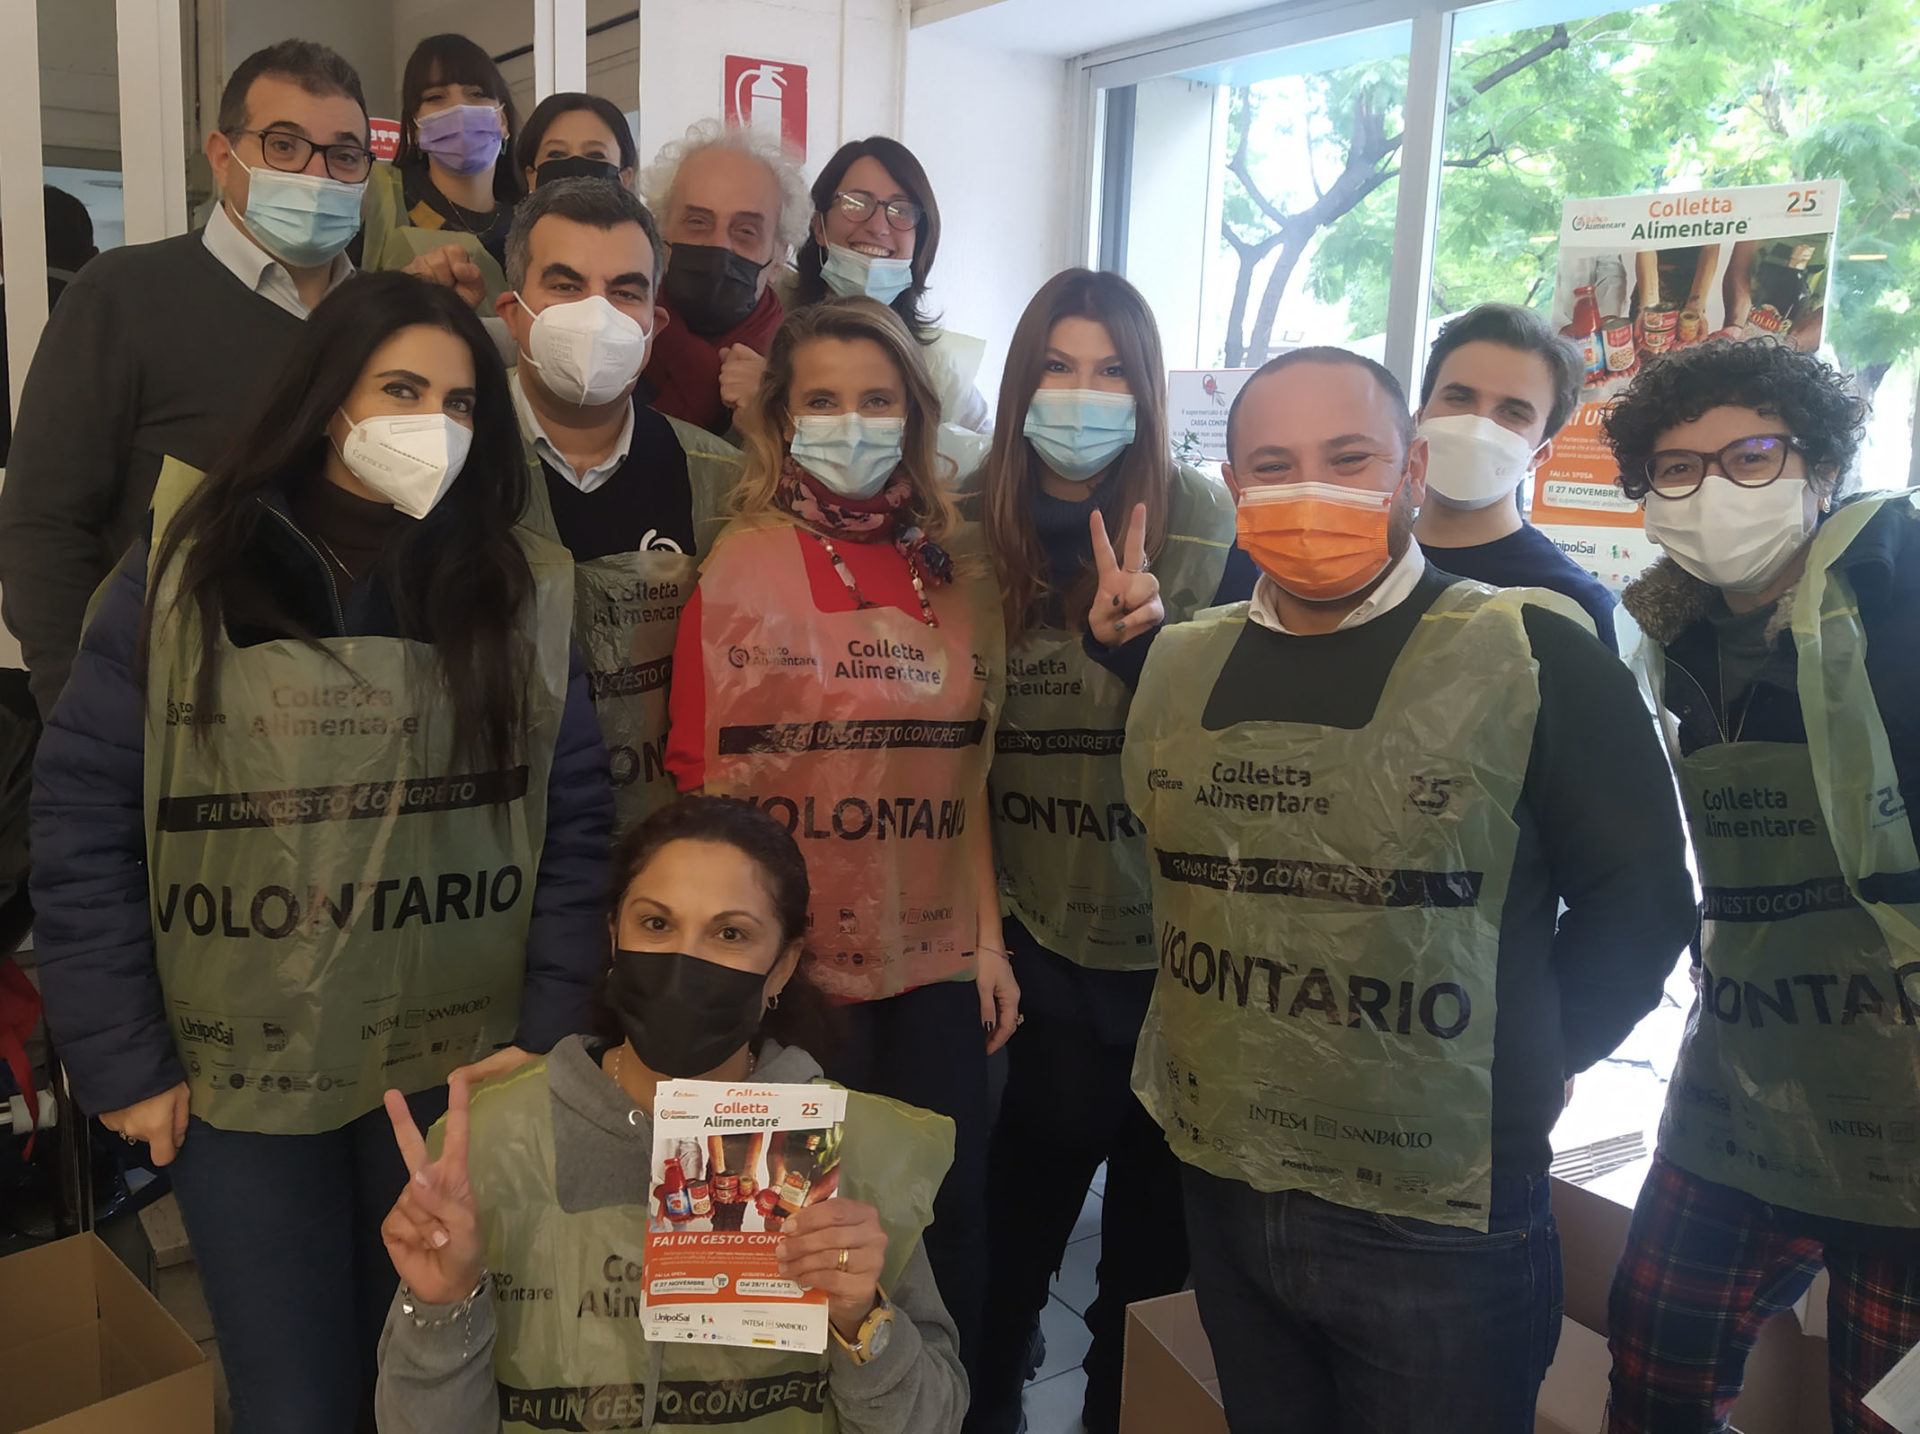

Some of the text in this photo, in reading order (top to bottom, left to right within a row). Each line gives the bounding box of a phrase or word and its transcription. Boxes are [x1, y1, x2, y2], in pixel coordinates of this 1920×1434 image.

[1649, 197, 1733, 218] Colletta
[1631, 218, 1748, 241] Alimentare
[1751, 312, 1778, 330] OLIO
[1555, 485, 1566, 494] 27
[1568, 486, 1620, 498] NOVEMBRE
[847, 638, 925, 662] Colletta
[834, 660, 941, 685] Alimentare
[1006, 659, 1068, 677] olletta
[1006, 678, 1083, 697] mentare
[250, 714, 420, 738] Alimentae
[783, 729, 813, 748] FAI
[850, 726, 902, 745] GESTO
[904, 726, 966, 743] CONCRET
[998, 734, 1126, 751] GESTO CONCRETO
[1211, 760, 1312, 788] Colletta
[197, 801, 223, 824] FAI
[229, 800, 262, 822] UN
[267, 793, 349, 821] GESTO
[1194, 785, 1331, 816] Alimentare
[1702, 786, 1788, 811] Colletta
[721, 794, 967, 841] OLONTARIO
[1000, 791, 1147, 842] ONTAR
[1210, 863, 1258, 886] GESTO
[1263, 867, 1397, 898] CONCRETO
[157, 864, 523, 940] VOLONTARIO
[1066, 901, 1153, 917] NTESA SANPA
[1773, 884, 1850, 913] CONC
[1161, 920, 1472, 1040] VOLONTARIO
[179, 1015, 235, 1046] UnipoSai
[714, 1102, 769, 1115] Colletta
[703, 1115, 780, 1129] Alimentare
[1249, 1104, 1433, 1150] INTESA SANPAOLO
[1826, 1118, 1884, 1140] INTESA
[652, 1234, 787, 1248] FAI UN GESTO CONC
[499, 1287, 554, 1302] entare
[654, 1311, 690, 1324] UnipolSai
[509, 1397, 542, 1421] FAI
[550, 1398, 584, 1423] UN
[592, 1390, 683, 1421] GESO
